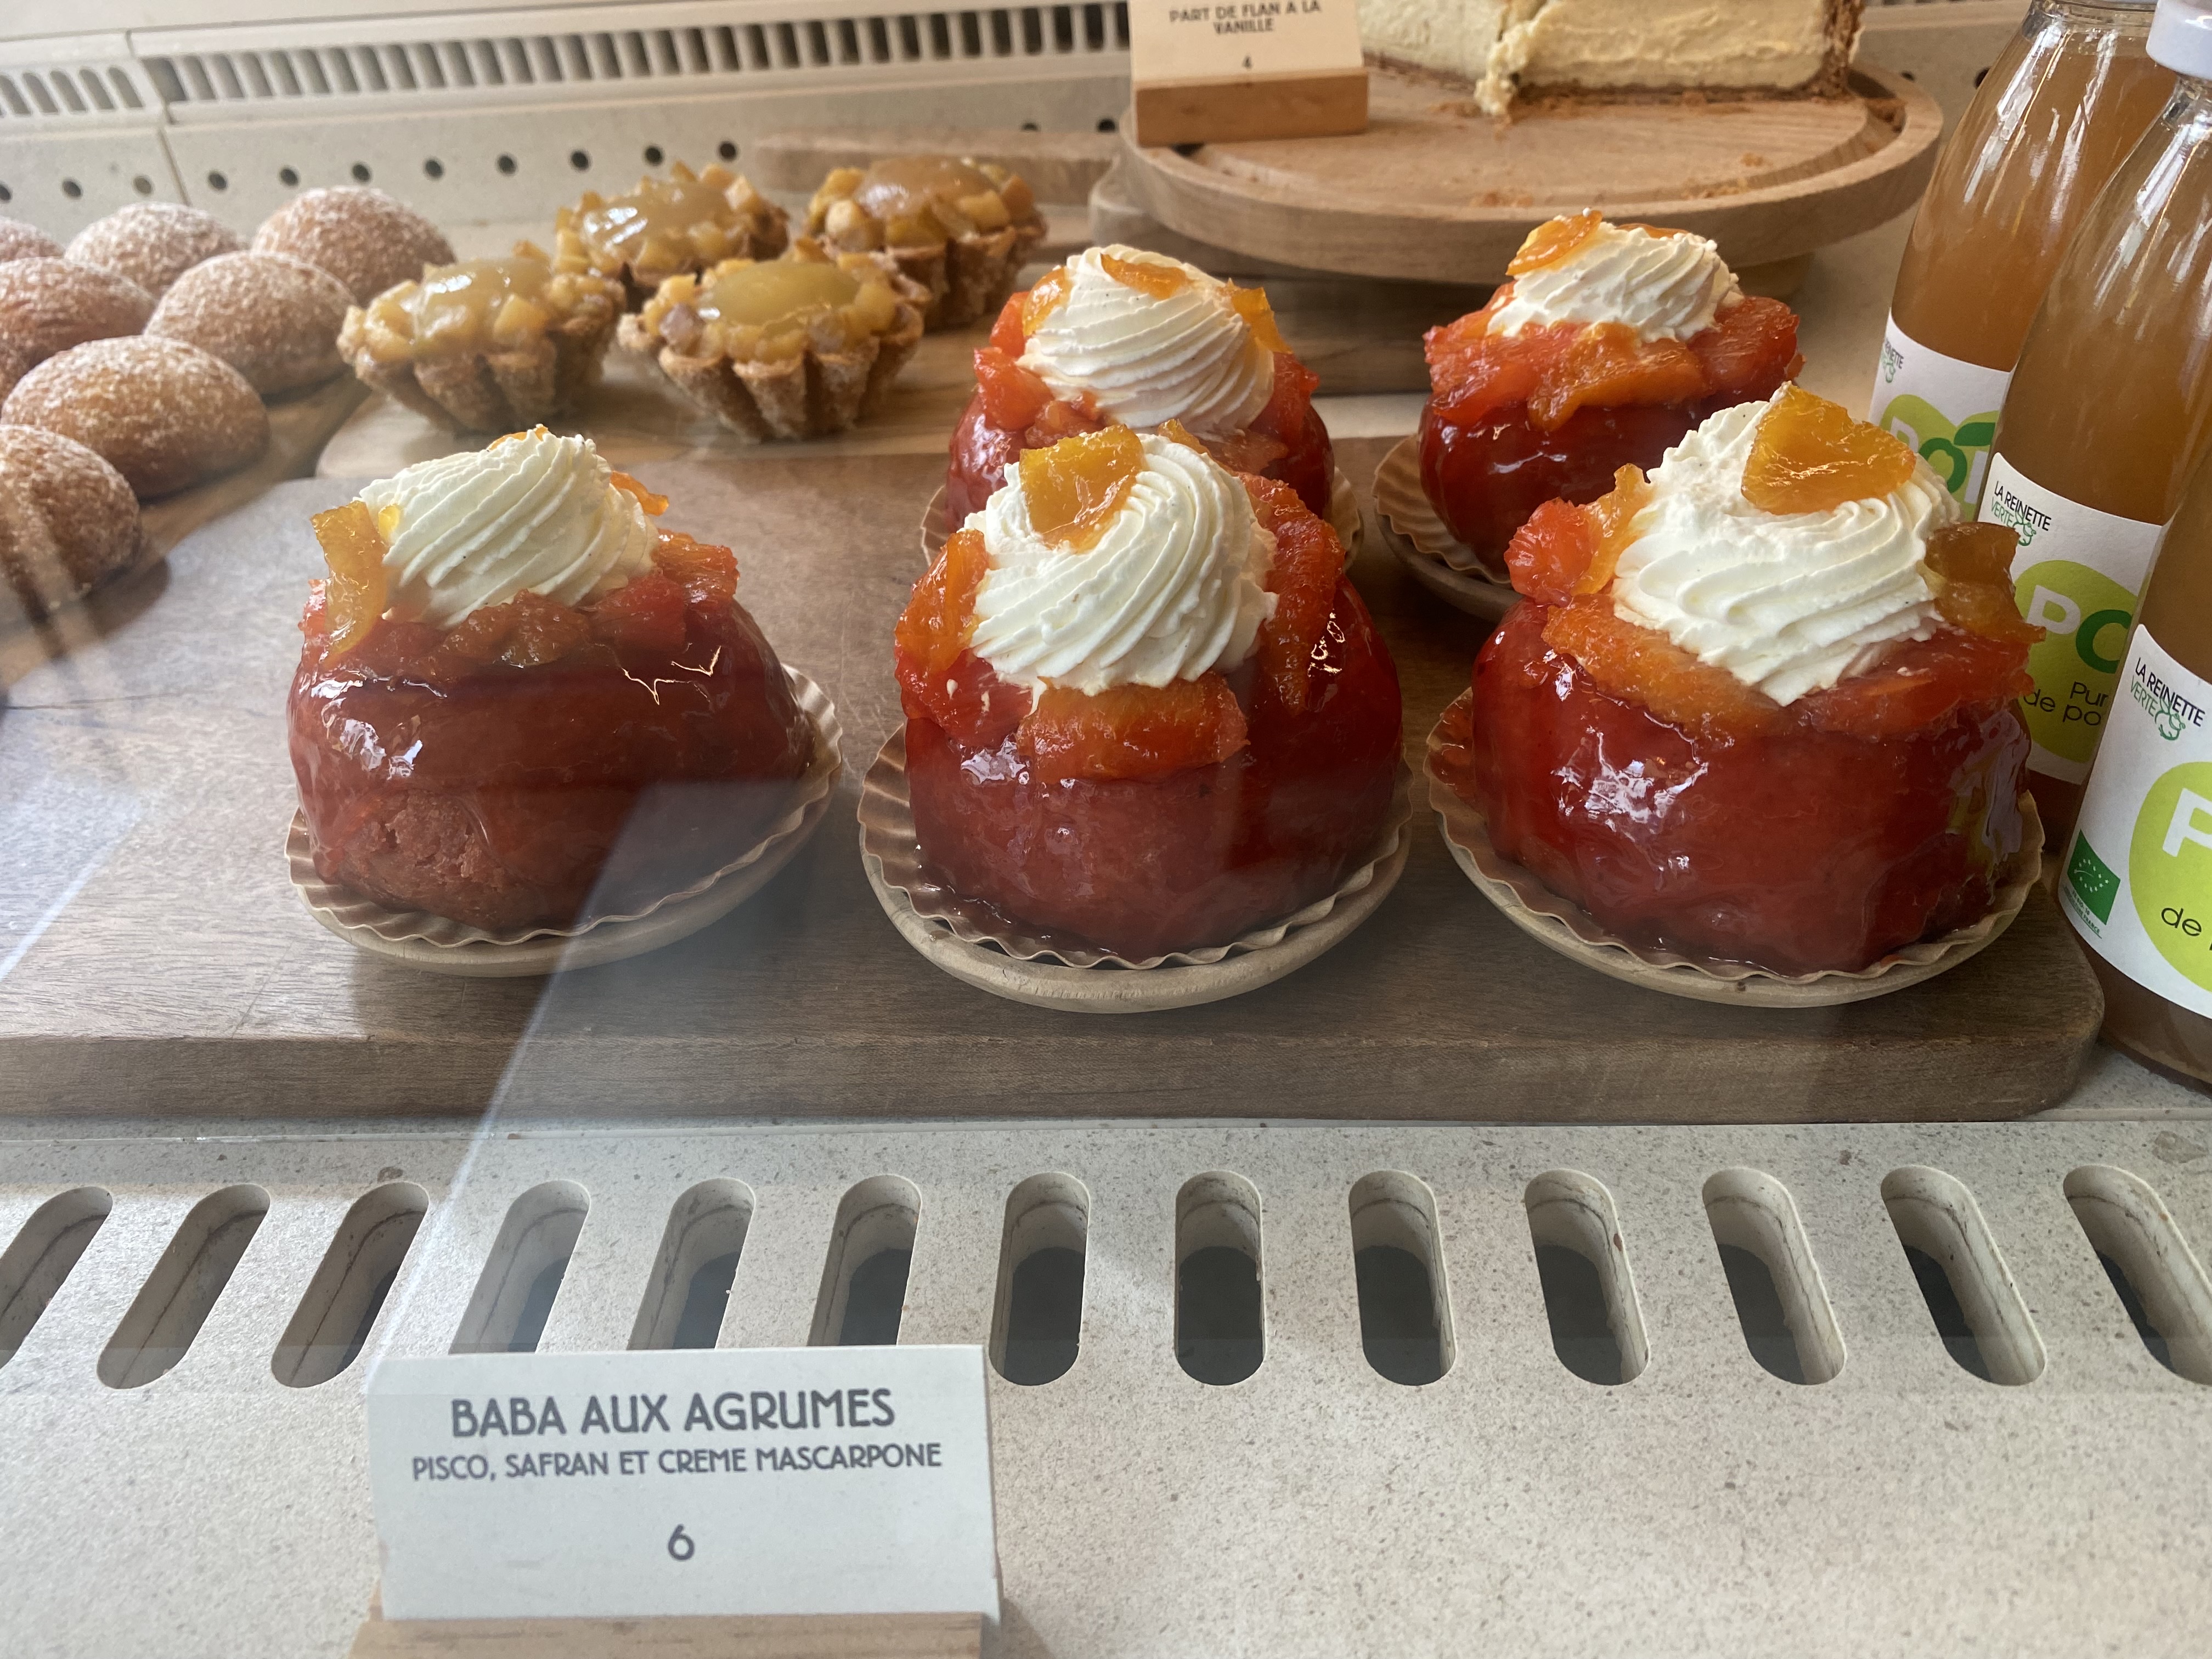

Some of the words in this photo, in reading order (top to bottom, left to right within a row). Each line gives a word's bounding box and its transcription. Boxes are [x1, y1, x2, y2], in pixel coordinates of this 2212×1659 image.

[1169, 8, 1209, 22] PART
[1215, 5, 1237, 19] DE
[1242, 3, 1279, 17] FLAN
[1286, 1, 1296, 13] A
[1302, 0, 1321, 13] LA
[1213, 18, 1273, 34] VANILLE
[1991, 496, 2014, 528] VERTE
[1994, 481, 2004, 501] LA
[2004, 491, 2051, 531] REINETTE
[2023, 689, 2055, 712] de
[2062, 704, 2101, 726] po
[2069, 681, 2108, 707] Pur
[2131, 674, 2158, 718] VERTE
[2135, 657, 2146, 683] LA
[2147, 672, 2205, 727] REINETTE
[2161, 907, 2202, 936] de
[452, 1397, 567, 1437] BABA
[580, 1393, 671, 1434] AUX
[684, 1388, 895, 1431] AGRUMES
[413, 1454, 496, 1481] PISCO,
[505, 1450, 610, 1478] SAFRAN
[619, 1450, 650, 1475] ET
[658, 1447, 747, 1474] CREME
[756, 1442, 942, 1471] MASCARPONE
[667, 1523, 695, 1562] 6
